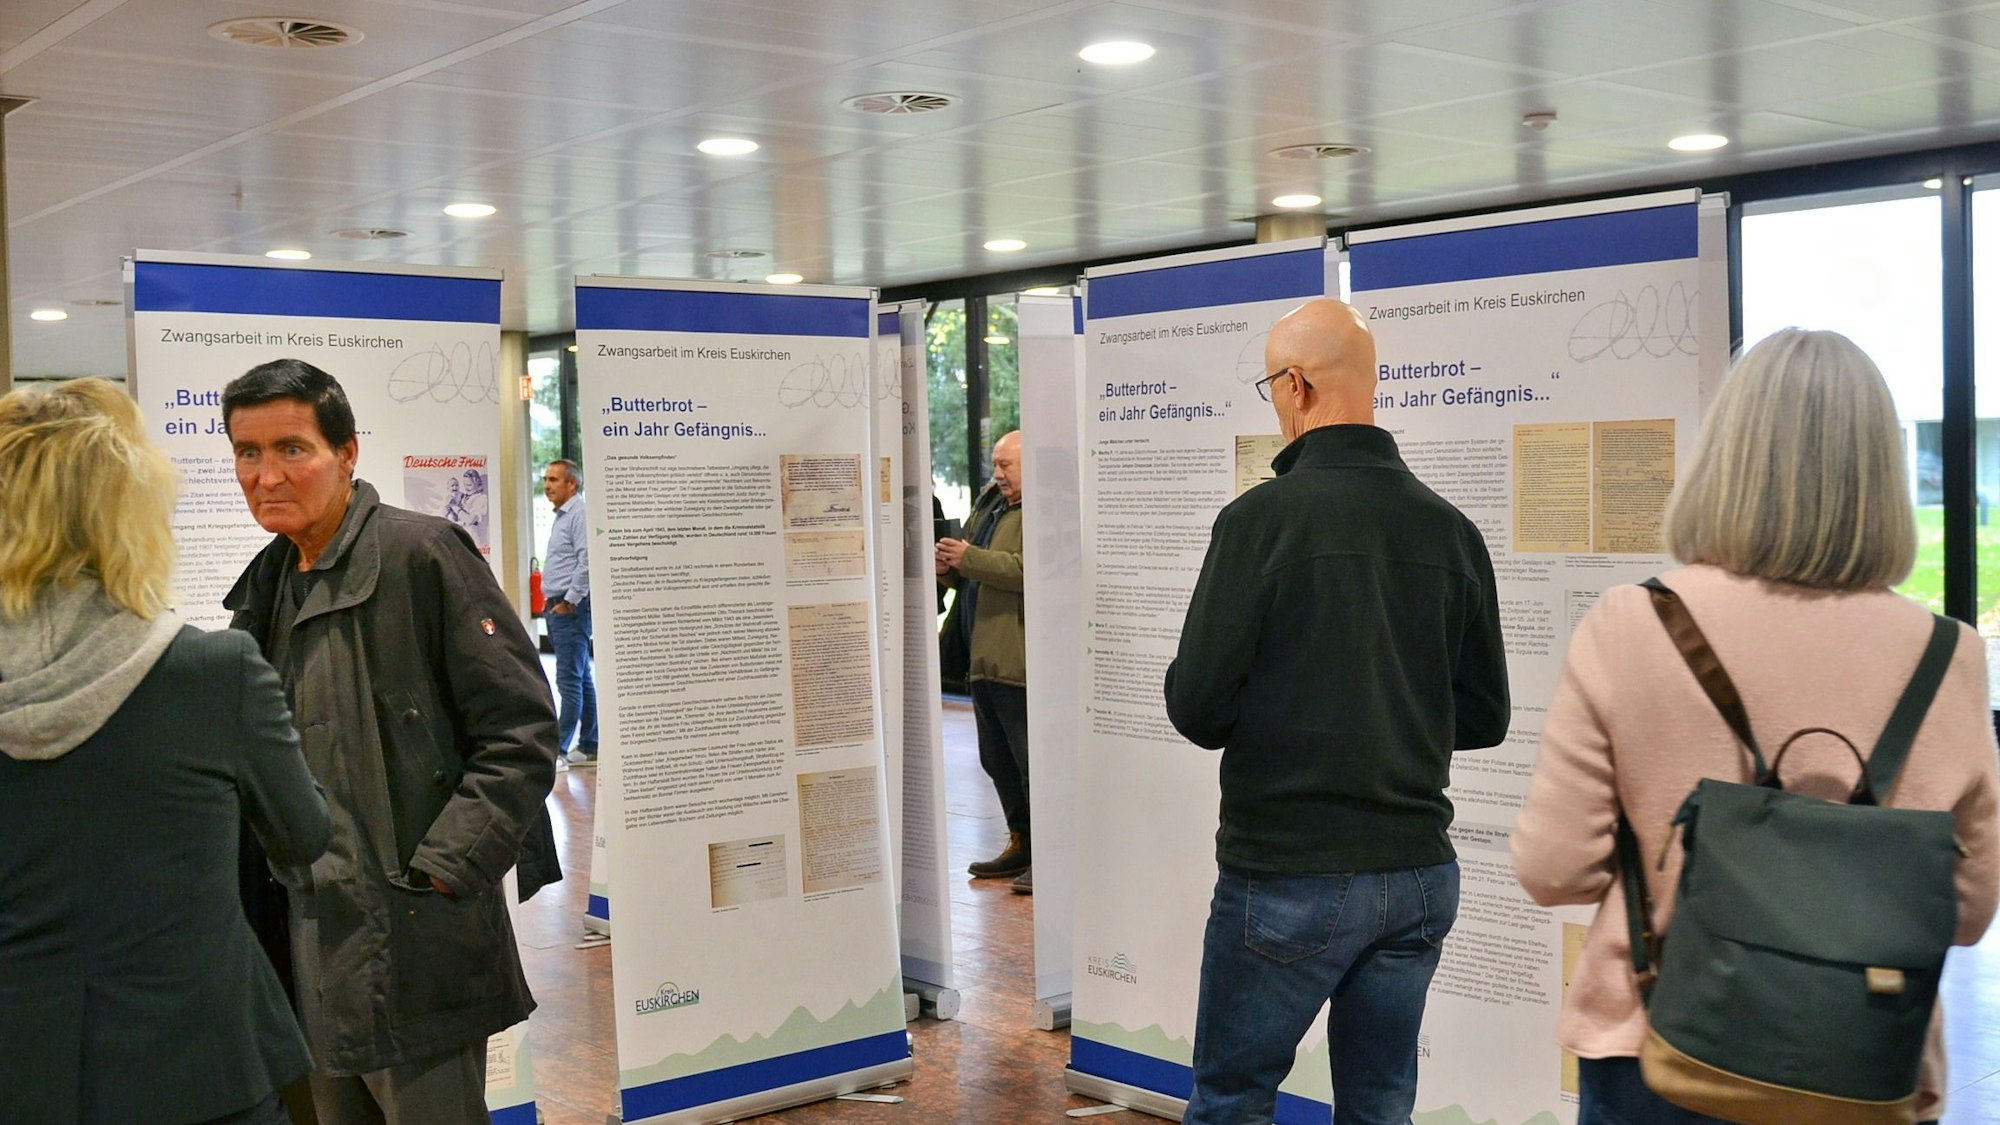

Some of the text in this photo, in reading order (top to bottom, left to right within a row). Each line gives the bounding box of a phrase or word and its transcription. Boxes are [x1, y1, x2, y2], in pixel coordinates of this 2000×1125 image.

[1369, 289, 1585, 320] Zwangsarbeit im Kreis Euskirchen
[161, 329, 404, 349] Zwangsarbeit im Kreis Euskirchen
[1100, 320, 1248, 345] Zwangsarbeit im Kreis Euskirchen
[598, 344, 791, 360] Zwangsarbeit im Kreis Euskirchen
[1379, 360, 1465, 380] Butterbrot
[164, 390, 221, 409] „Butt
[1100, 380, 1166, 400] „Butterbrot
[1400, 390, 1436, 408] Jahr
[602, 397, 693, 414] „Butterbrot
[1099, 407, 1116, 422] ein
[1120, 406, 1145, 421] Jahr
[165, 418, 226, 435] ein Ja
[603, 422, 766, 440] ein Jahr Gefängnis...
[404, 456, 487, 468] Deutsche Frau!
[1088, 964, 1136, 984] EUSKIRCHEN
[636, 989, 700, 1012] EUSKIRCHEN
